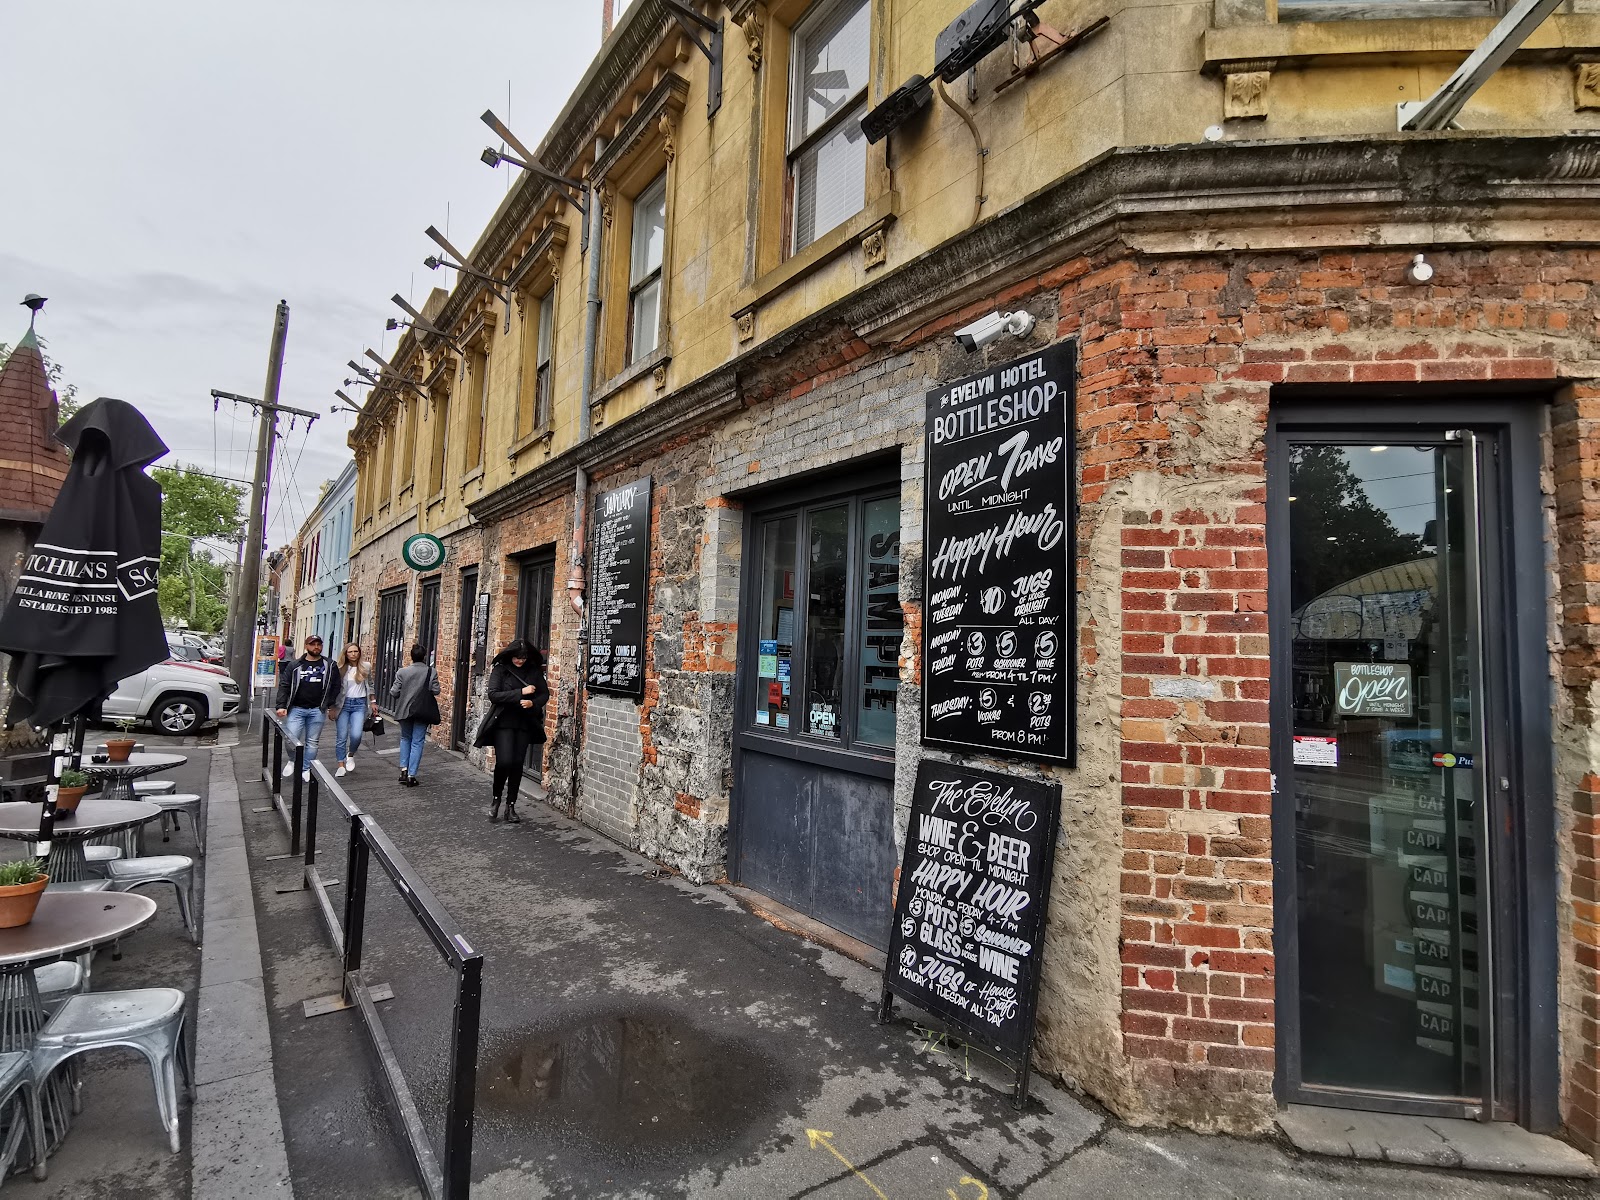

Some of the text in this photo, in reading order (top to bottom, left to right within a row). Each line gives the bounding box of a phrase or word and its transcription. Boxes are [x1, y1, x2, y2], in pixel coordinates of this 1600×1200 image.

[951, 375, 994, 406] EVELYN
[1001, 358, 1046, 389] HOTEL
[934, 381, 1058, 444] BOTTLESHOP
[939, 430, 1062, 500] OPEN 7 DAYS
[604, 487, 637, 517] JANUARY
[948, 488, 1030, 512] UNTIL MIDNIGHT
[932, 503, 1063, 582] Happy Hour
[1011, 569, 1052, 598] JUGS
[931, 585, 961, 606] MONDAY
[1019, 596, 1027, 604] OF
[933, 603, 963, 623] TUESDAY
[1014, 597, 1050, 616] DRAUGHT
[1019, 616, 1059, 625] ALL DAY!
[930, 628, 961, 649] MONDAY
[631, 645, 636, 656] UP
[941, 646, 947, 654] TO
[932, 654, 956, 673] FRIDAY
[966, 657, 984, 669] POTS
[1036, 658, 1055, 668] WINE
[1351, 665, 1393, 676] BOTTLESHOP
[986, 671, 1006, 680] FROM
[1007, 670, 1016, 682] 4
[1030, 671, 1037, 683] 7
[1007, 695, 1014, 707] &
[1339, 677, 1407, 713] Open
[810, 710, 836, 726] OPEN
[978, 710, 1051, 728] VODKAS POTS
[992, 729, 1015, 741] FROM
[1017, 730, 1025, 743] 8
[929, 780, 1037, 832] The Evelyn
[919, 813, 1031, 873] WINE & BEER
[1407, 831, 1440, 849] CAPI
[918, 843, 941, 858] SHOP
[944, 851, 966, 867] OPEN
[988, 864, 1029, 886] MIDNIGHT
[1413, 867, 1447, 887] CAPI
[911, 858, 1030, 920] HAPPY HOUR
[915, 886, 946, 906] MONDAY
[957, 902, 984, 920] FRIDAY
[1008, 923, 1018, 933] PM
[924, 902, 958, 933] POTS
[974, 921, 1032, 956] SCHOONER
[920, 922, 962, 958] GLASS
[964, 942, 974, 950] OF
[979, 945, 1020, 984] WINE
[919, 956, 966, 993] JUGS
[964, 981, 978, 993] OF
[979, 980, 1016, 1000] House
[899, 966, 928, 987] MONDAY
[936, 984, 970, 1009] TUESDAY
[970, 1003, 984, 1018] ALL
[987, 1010, 1004, 1028] DAY
[985, 998, 1018, 1019] Draft
